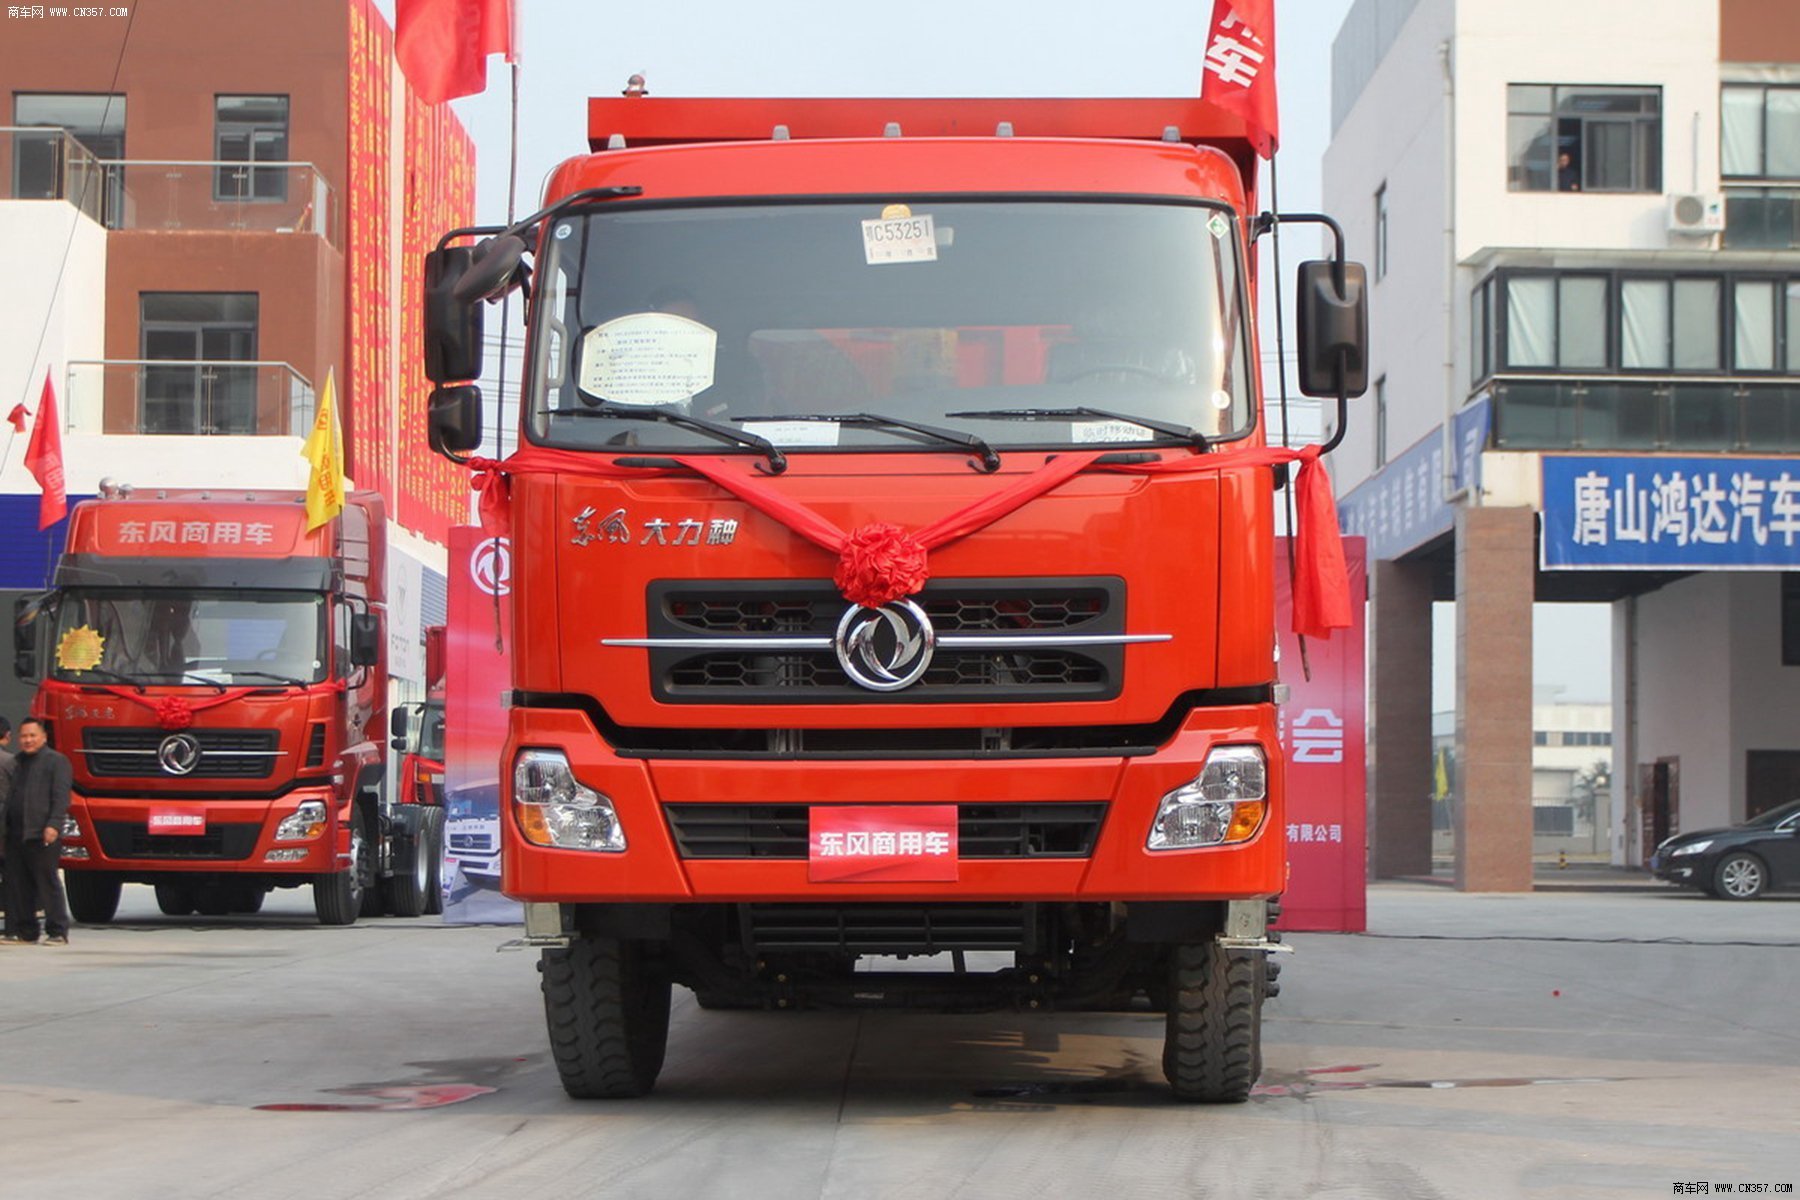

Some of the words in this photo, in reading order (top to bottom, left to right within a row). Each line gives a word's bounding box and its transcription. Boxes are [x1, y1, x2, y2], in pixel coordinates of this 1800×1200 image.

[1573, 470, 1800, 546] 唐山鸿达汽车
[119, 521, 273, 544] 东风商用车
[640, 518, 738, 545] 大力神
[1279, 708, 1344, 764] 会
[820, 831, 949, 856] 东风商用车
[1286, 823, 1342, 843] 有限公司
